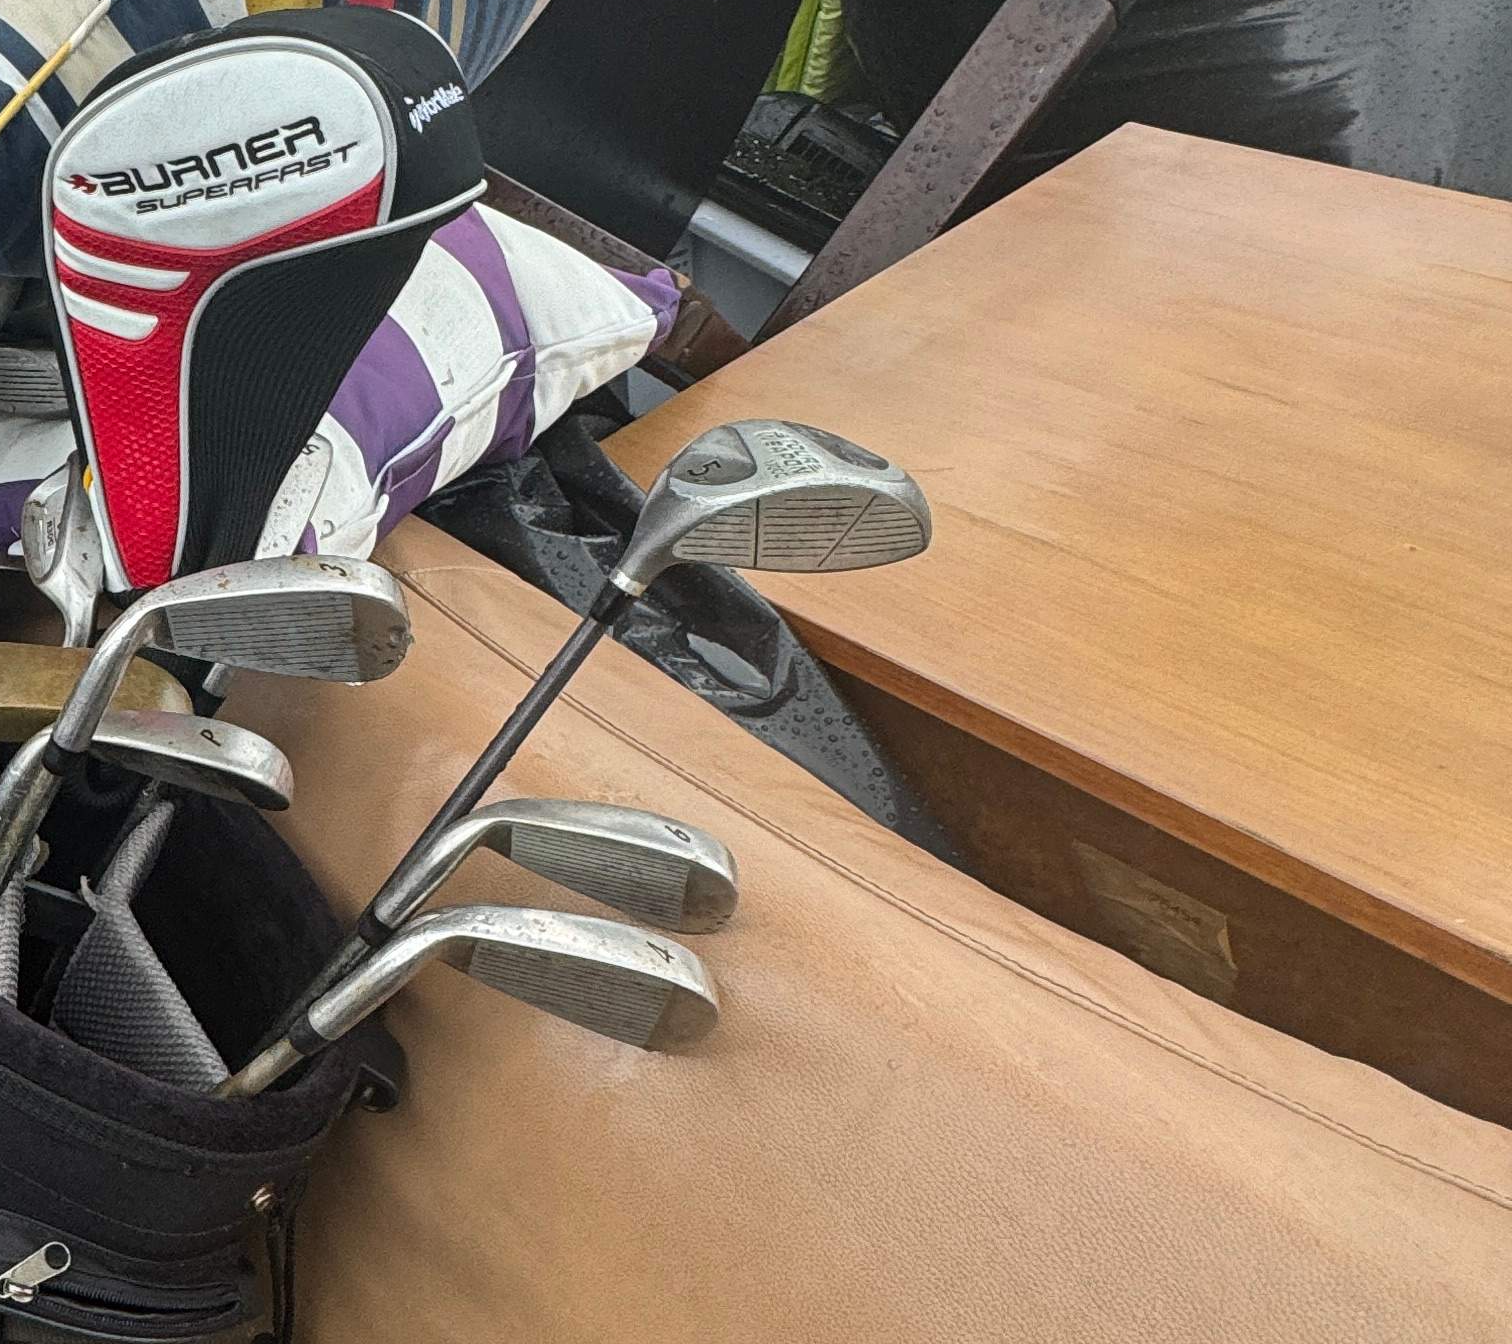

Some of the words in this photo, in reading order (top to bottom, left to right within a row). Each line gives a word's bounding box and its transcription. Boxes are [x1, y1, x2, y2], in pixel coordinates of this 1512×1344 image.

[96, 114, 327, 198] BURNER
[136, 141, 359, 216] SUPERFAST
[688, 460, 722, 477] 5
[318, 562, 348, 578] 3
[199, 728, 222, 747] P
[646, 940, 676, 964] 4
